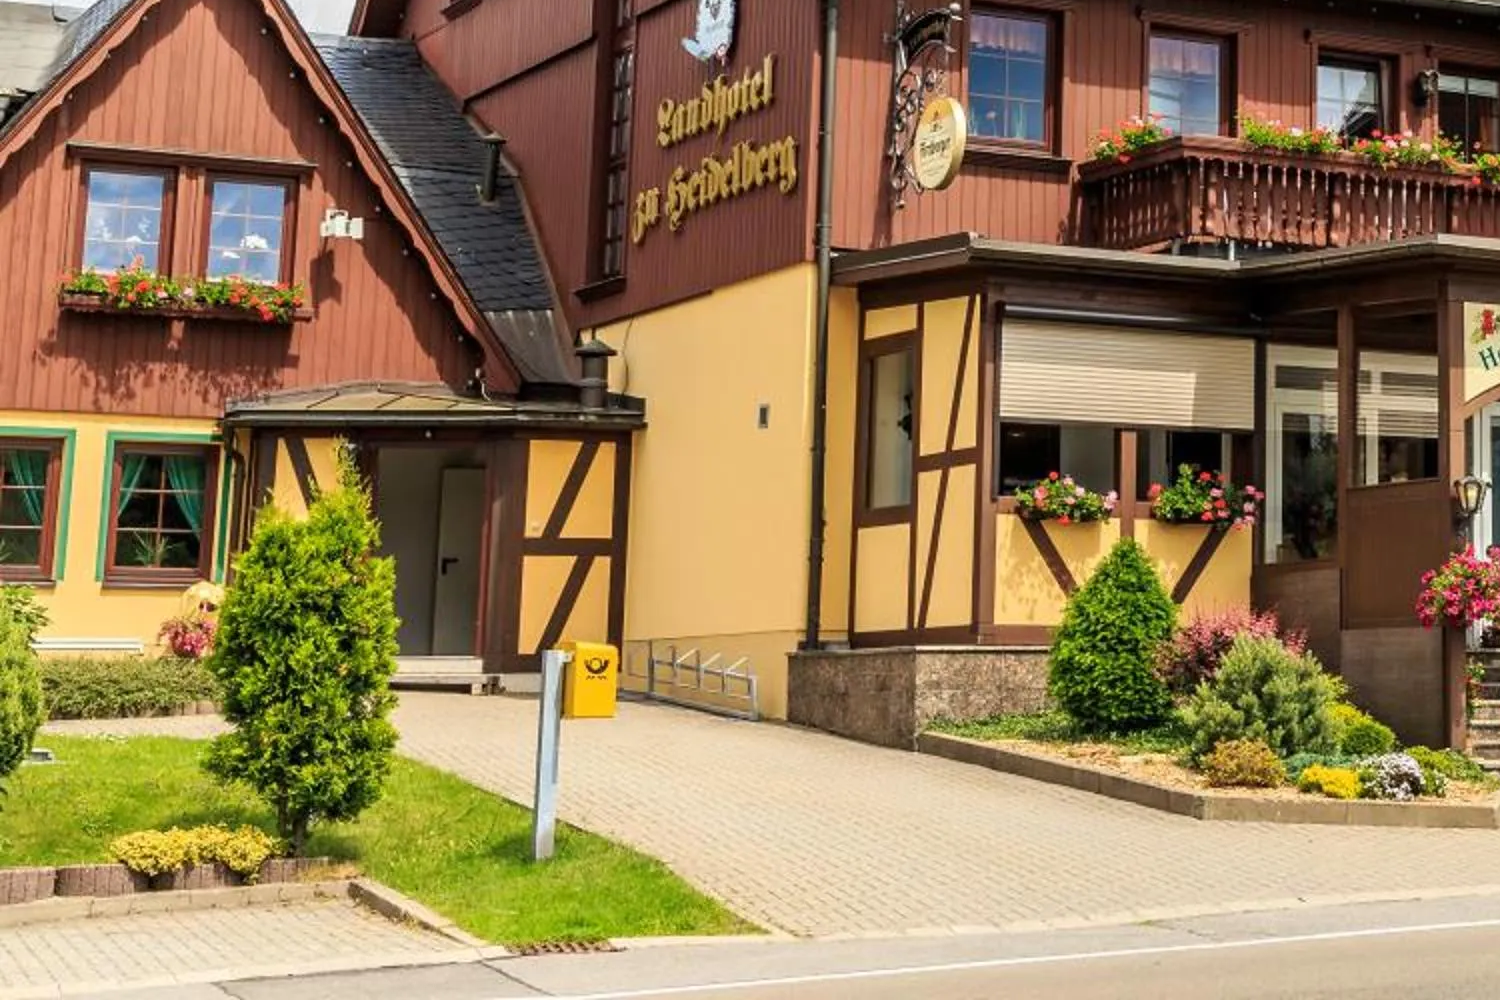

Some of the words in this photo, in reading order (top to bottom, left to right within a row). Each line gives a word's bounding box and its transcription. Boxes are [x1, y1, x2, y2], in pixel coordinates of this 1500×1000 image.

[657, 53, 773, 147] Landhotel
[632, 187, 661, 244] zu
[665, 135, 798, 232] Heidelberg
